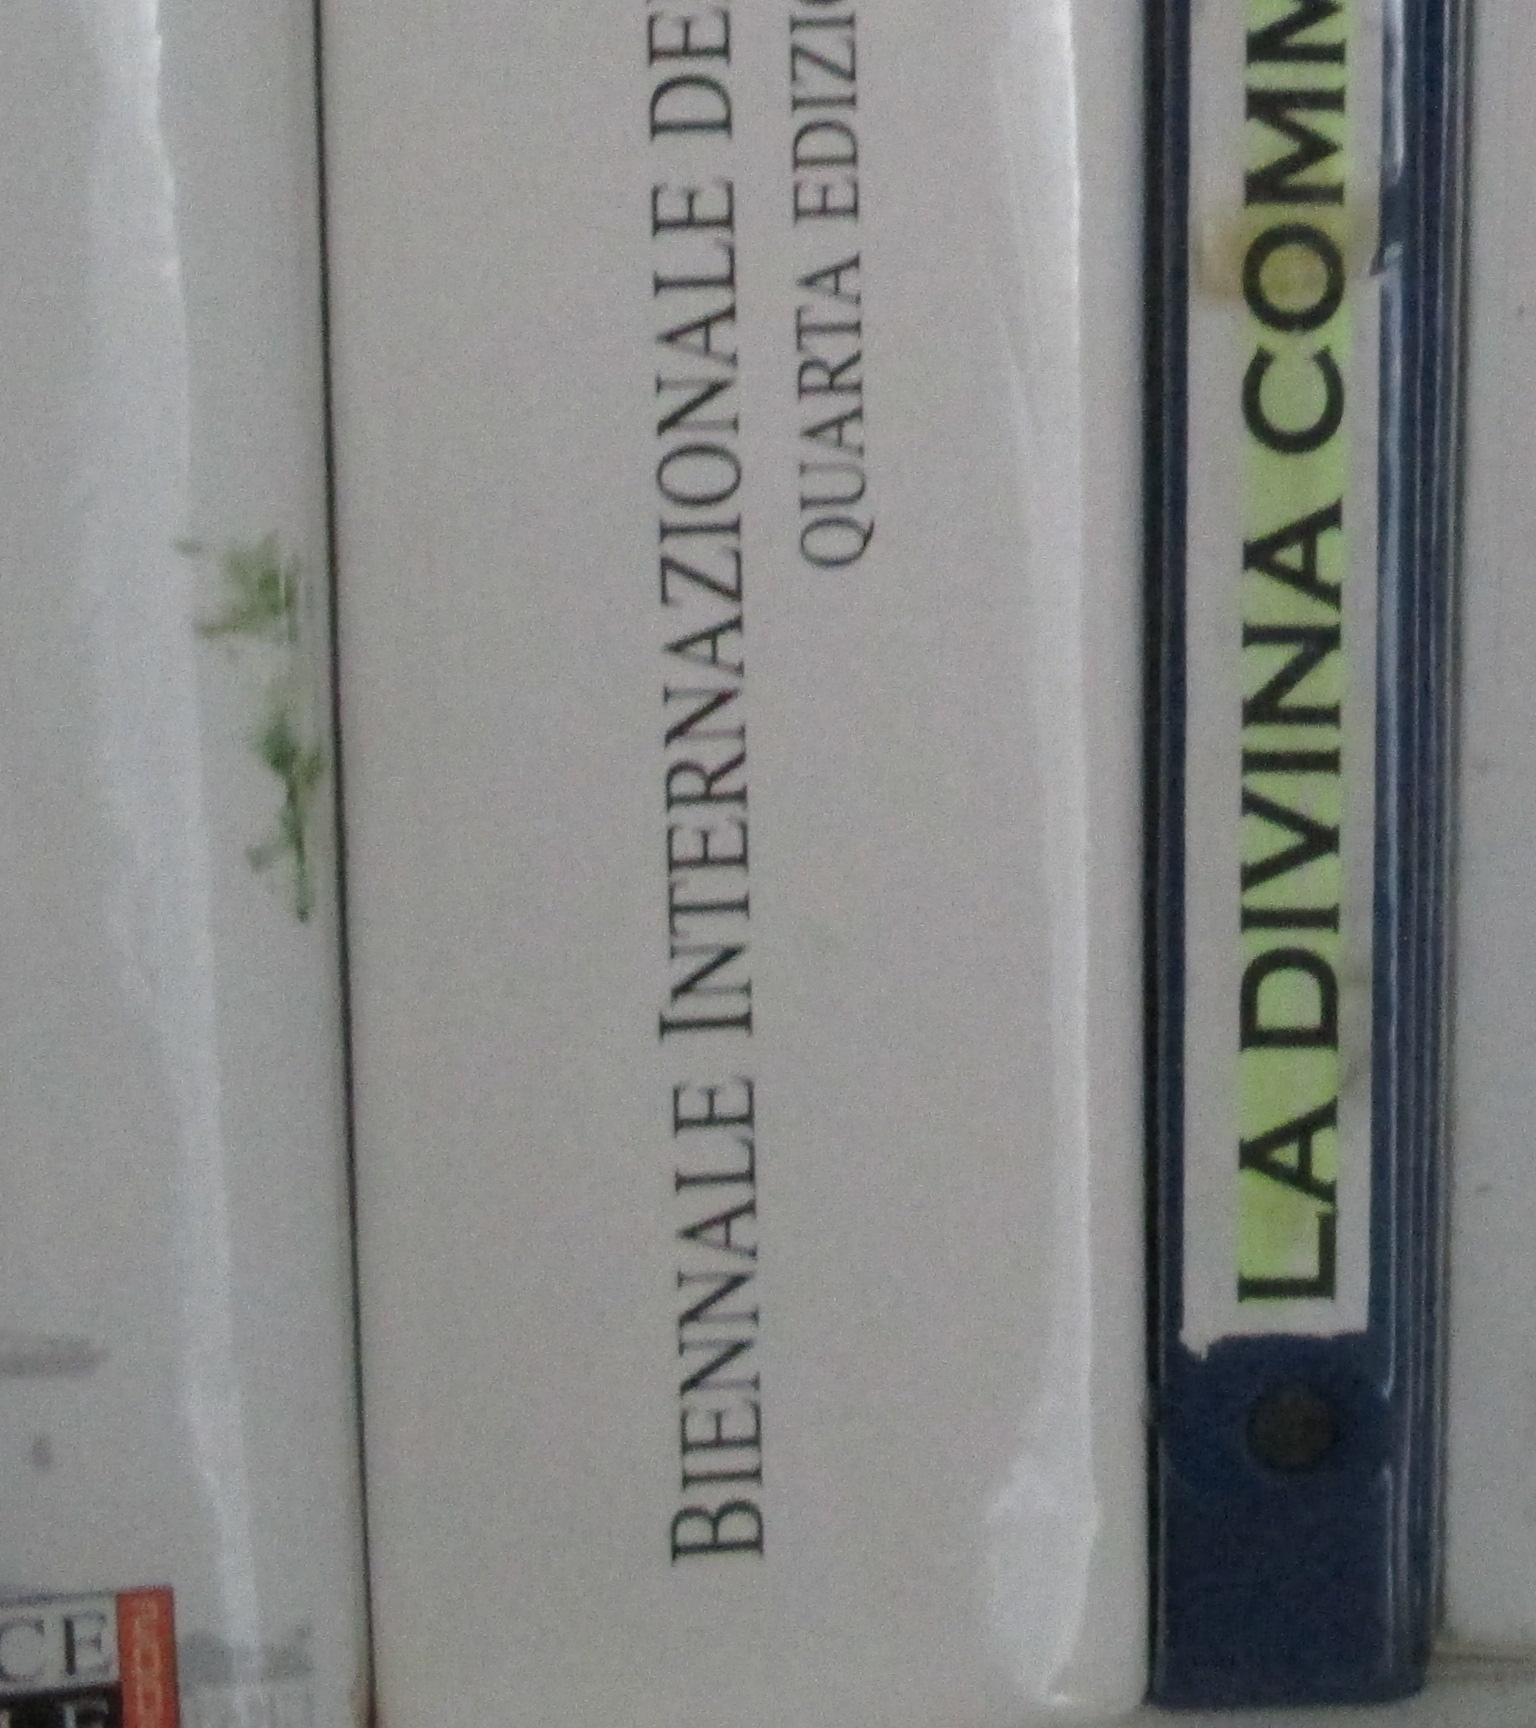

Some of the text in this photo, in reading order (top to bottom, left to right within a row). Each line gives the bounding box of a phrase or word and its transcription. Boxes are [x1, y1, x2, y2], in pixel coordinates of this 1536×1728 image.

[650, 181, 754, 1041] INTERNAZIONALE
[794, 253, 876, 570] QUARTA
[1238, 498, 1343, 1053] DIVINA
[669, 1079, 765, 1564] BIENNALE
[1236, 1095, 1339, 1303] LA
